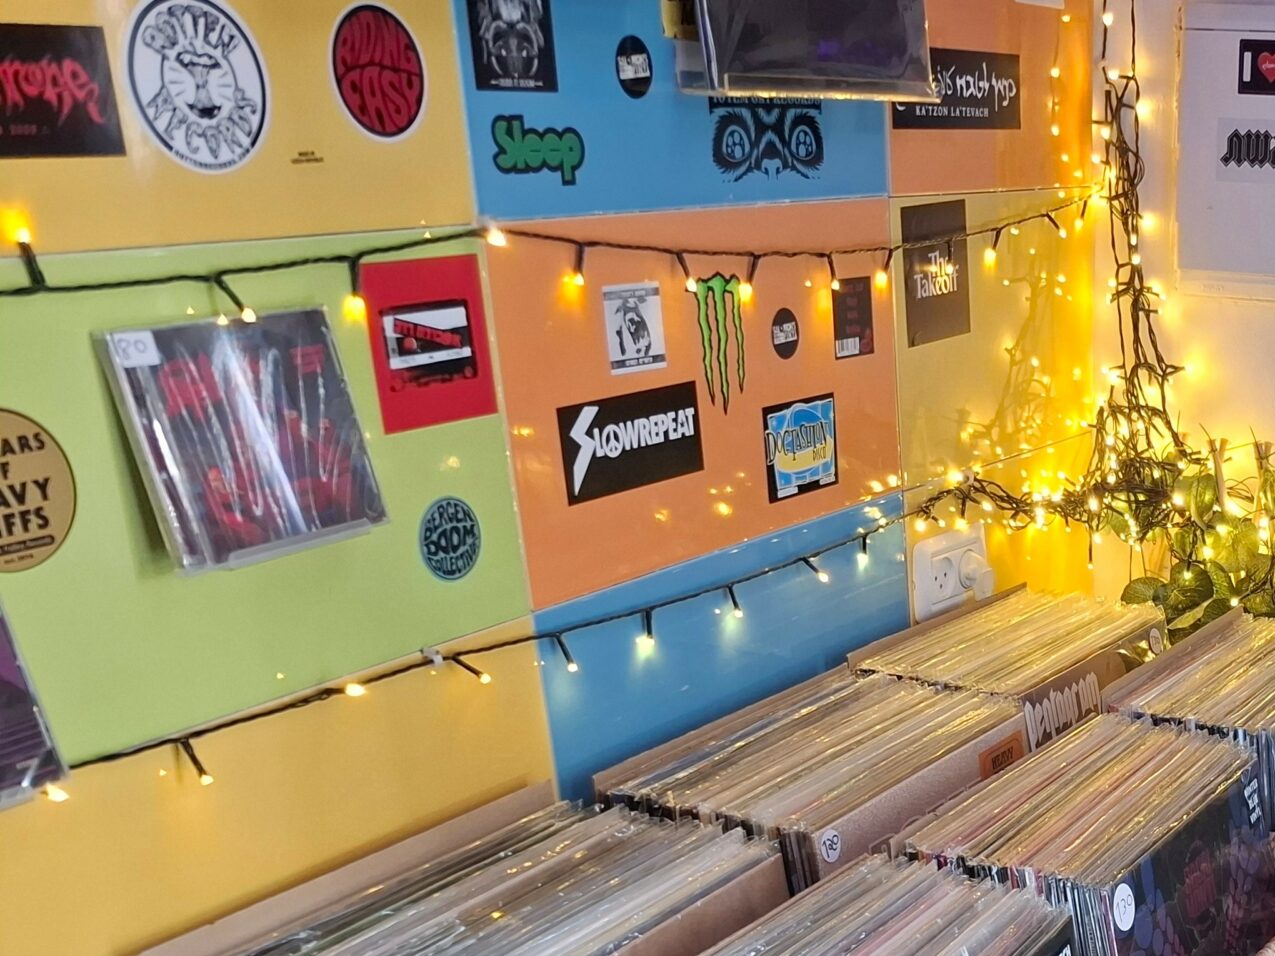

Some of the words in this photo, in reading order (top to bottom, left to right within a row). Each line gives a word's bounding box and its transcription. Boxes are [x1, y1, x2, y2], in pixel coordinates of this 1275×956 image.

[339, 10, 418, 74] RIDING
[1242, 51, 1252, 82] I
[340, 65, 421, 135] EASY
[915, 105, 948, 117] KA'TZON
[950, 106, 989, 118] LA'TEVACH
[494, 118, 582, 182] Sleep
[913, 264, 960, 300] Takeoff
[423, 500, 476, 542] BERGEN
[424, 523, 475, 557] DOOM
[821, 834, 840, 859] 120
[1115, 893, 1133, 924] 130
